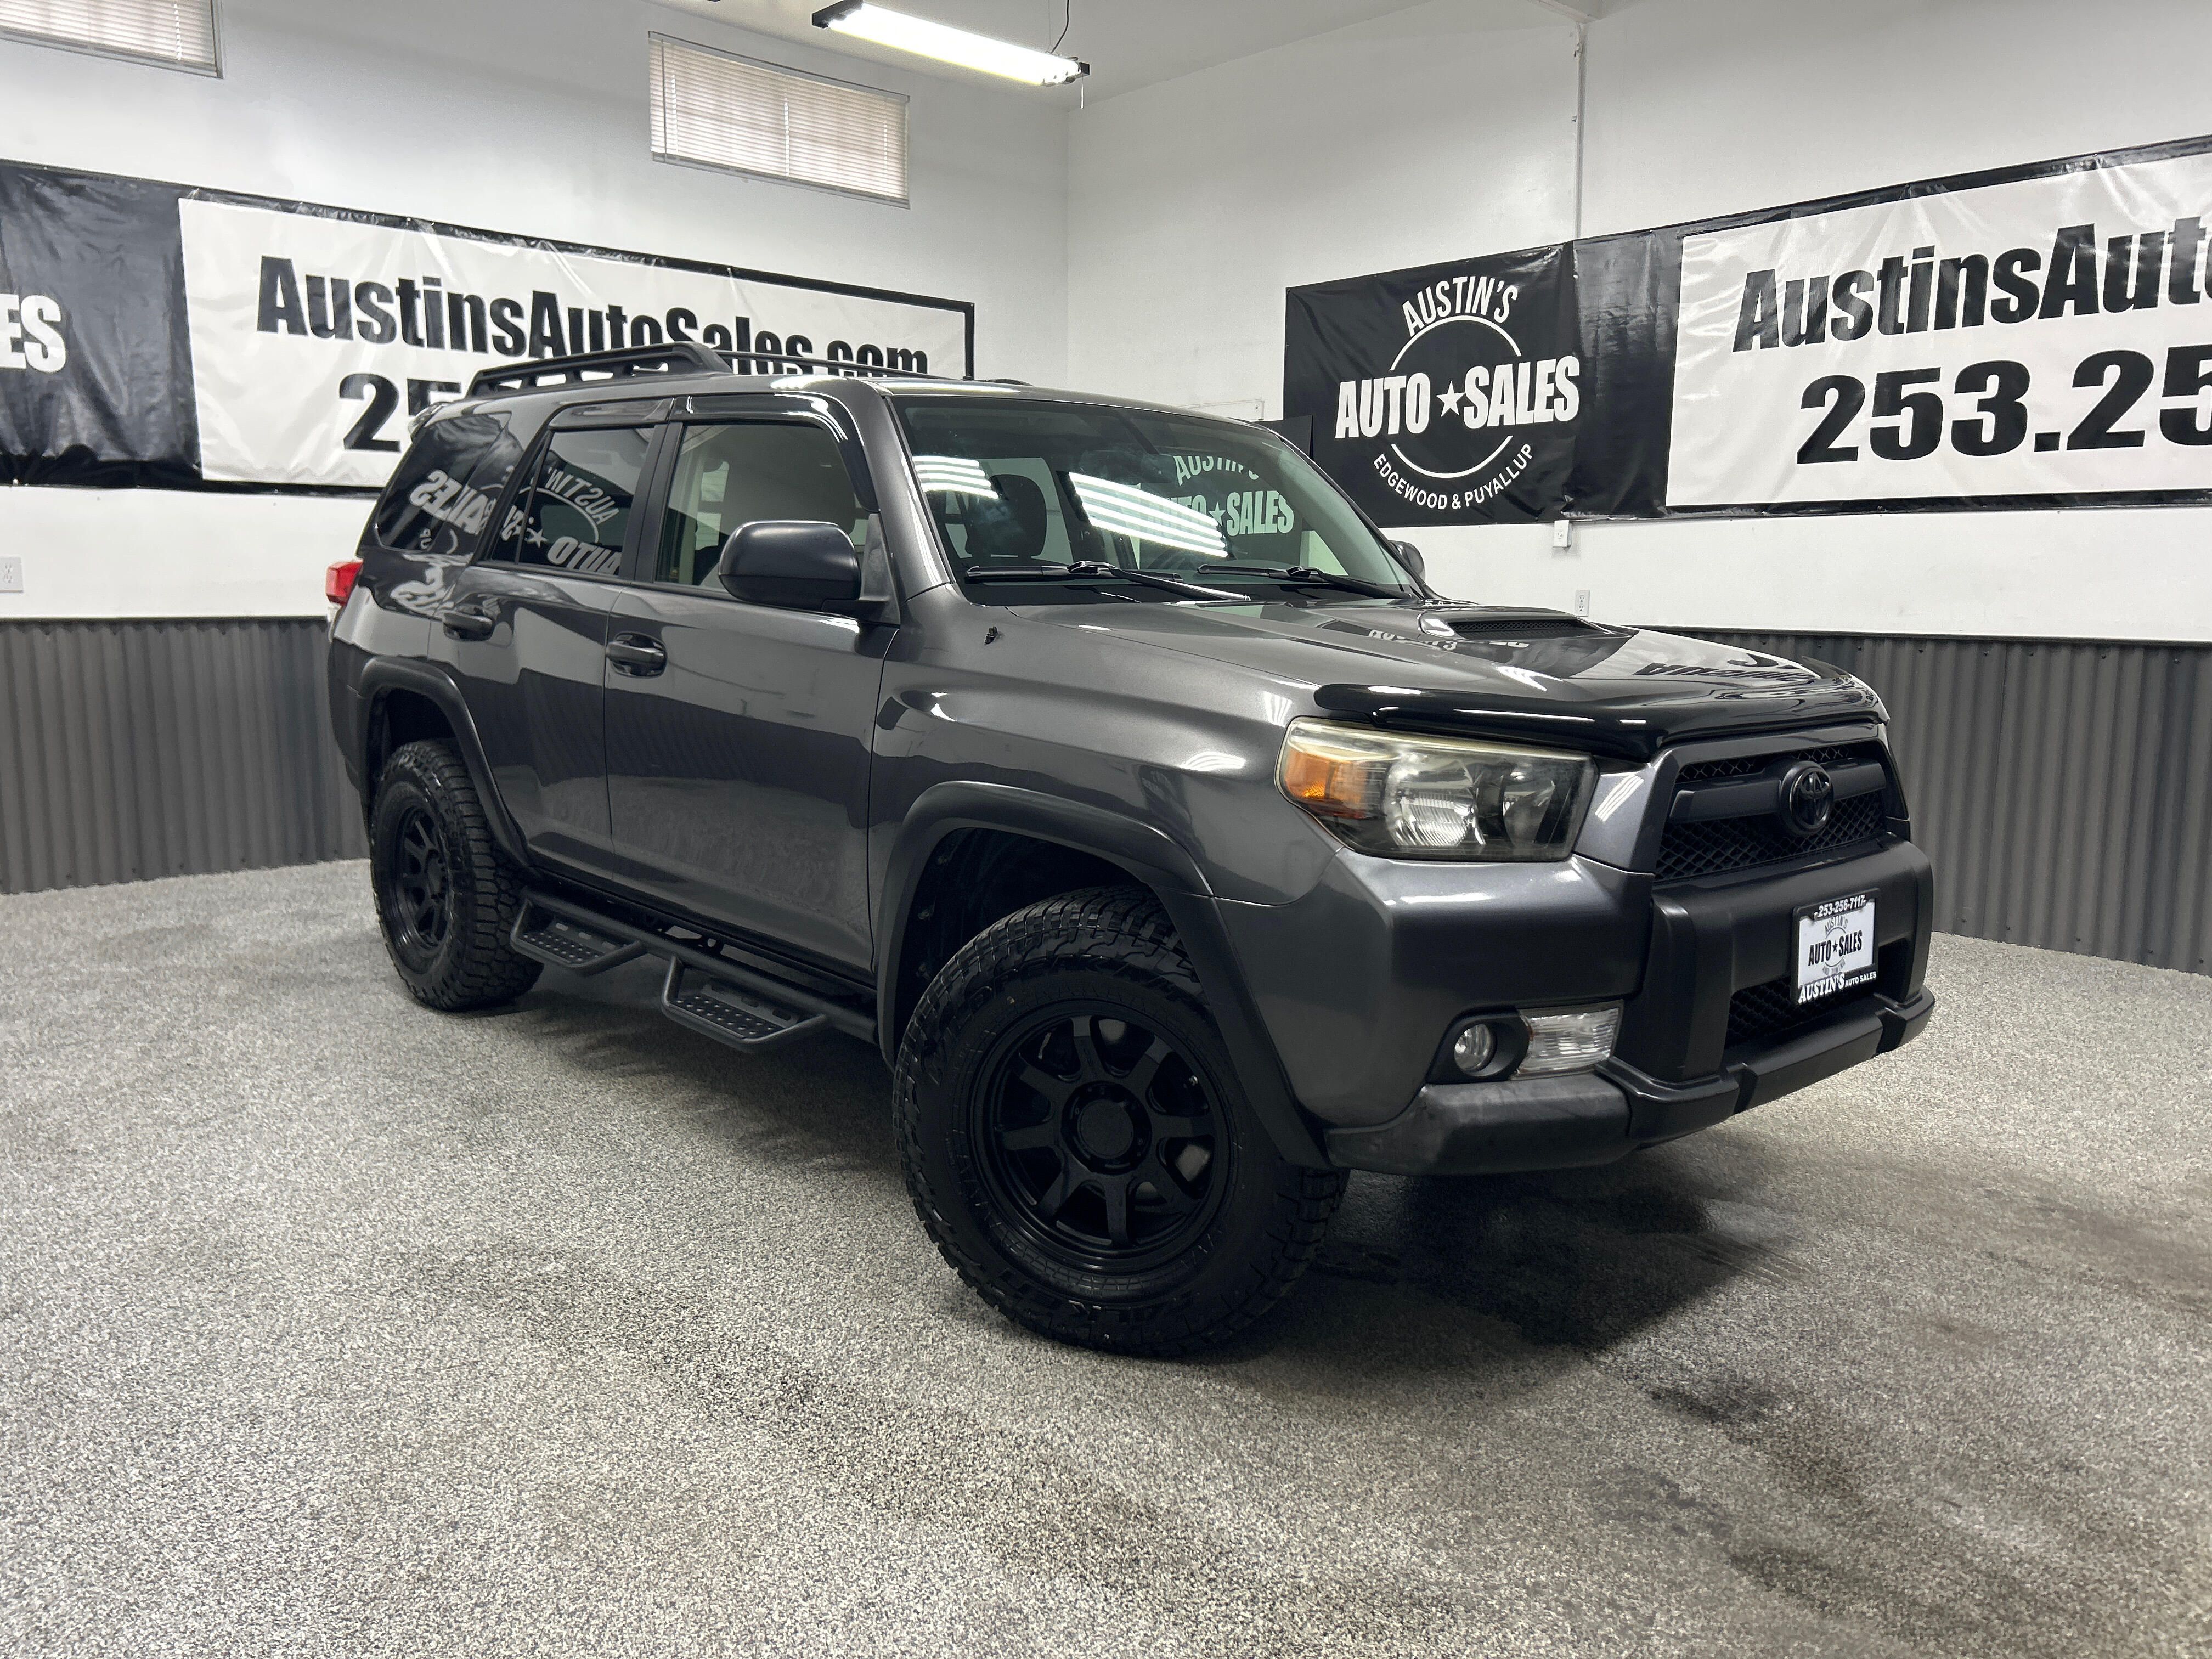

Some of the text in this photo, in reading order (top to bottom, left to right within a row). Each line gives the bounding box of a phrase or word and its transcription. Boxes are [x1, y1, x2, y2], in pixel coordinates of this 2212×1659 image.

[257, 255, 927, 376] AustinsAutoSalescom
[1402, 276, 1517, 337] AUSTIN'S
[1733, 217, 2212, 352] AustinsAut
[1335, 356, 1580, 439] AUTO SALES
[1796, 344, 2212, 465] 253.25
[1373, 443, 1533, 510] EDGEWOOD & PUYALLUP
[1227, 491, 1294, 537] SALES
[1808, 930, 1863, 966] AUTO SALES
[1798, 971, 1876, 1003] AUSTIN'S AUTO SALES
